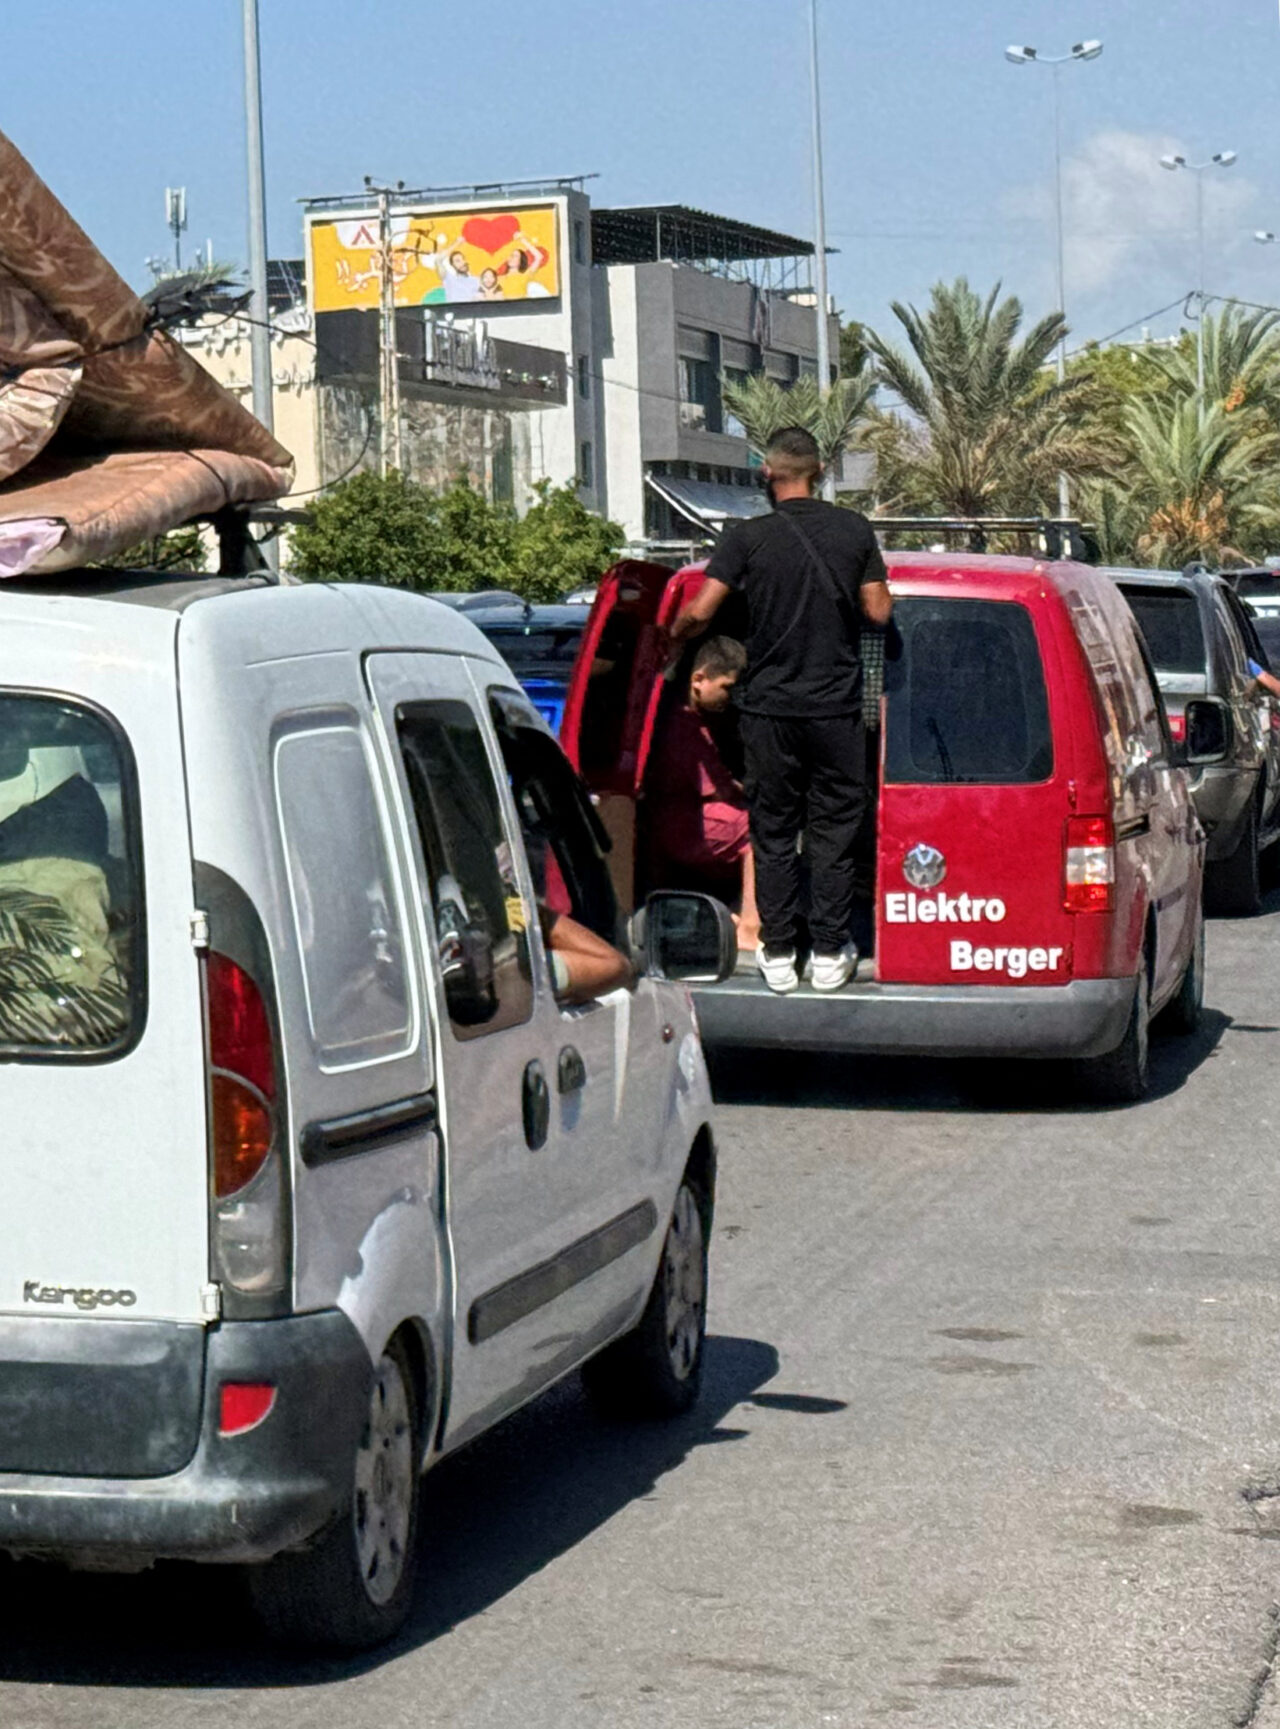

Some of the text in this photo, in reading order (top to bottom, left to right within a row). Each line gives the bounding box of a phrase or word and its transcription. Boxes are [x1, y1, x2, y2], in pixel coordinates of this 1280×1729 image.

[885, 892, 1006, 923] Elektro
[950, 940, 1063, 978] Berger
[23, 1280, 137, 1310] Kangoo
